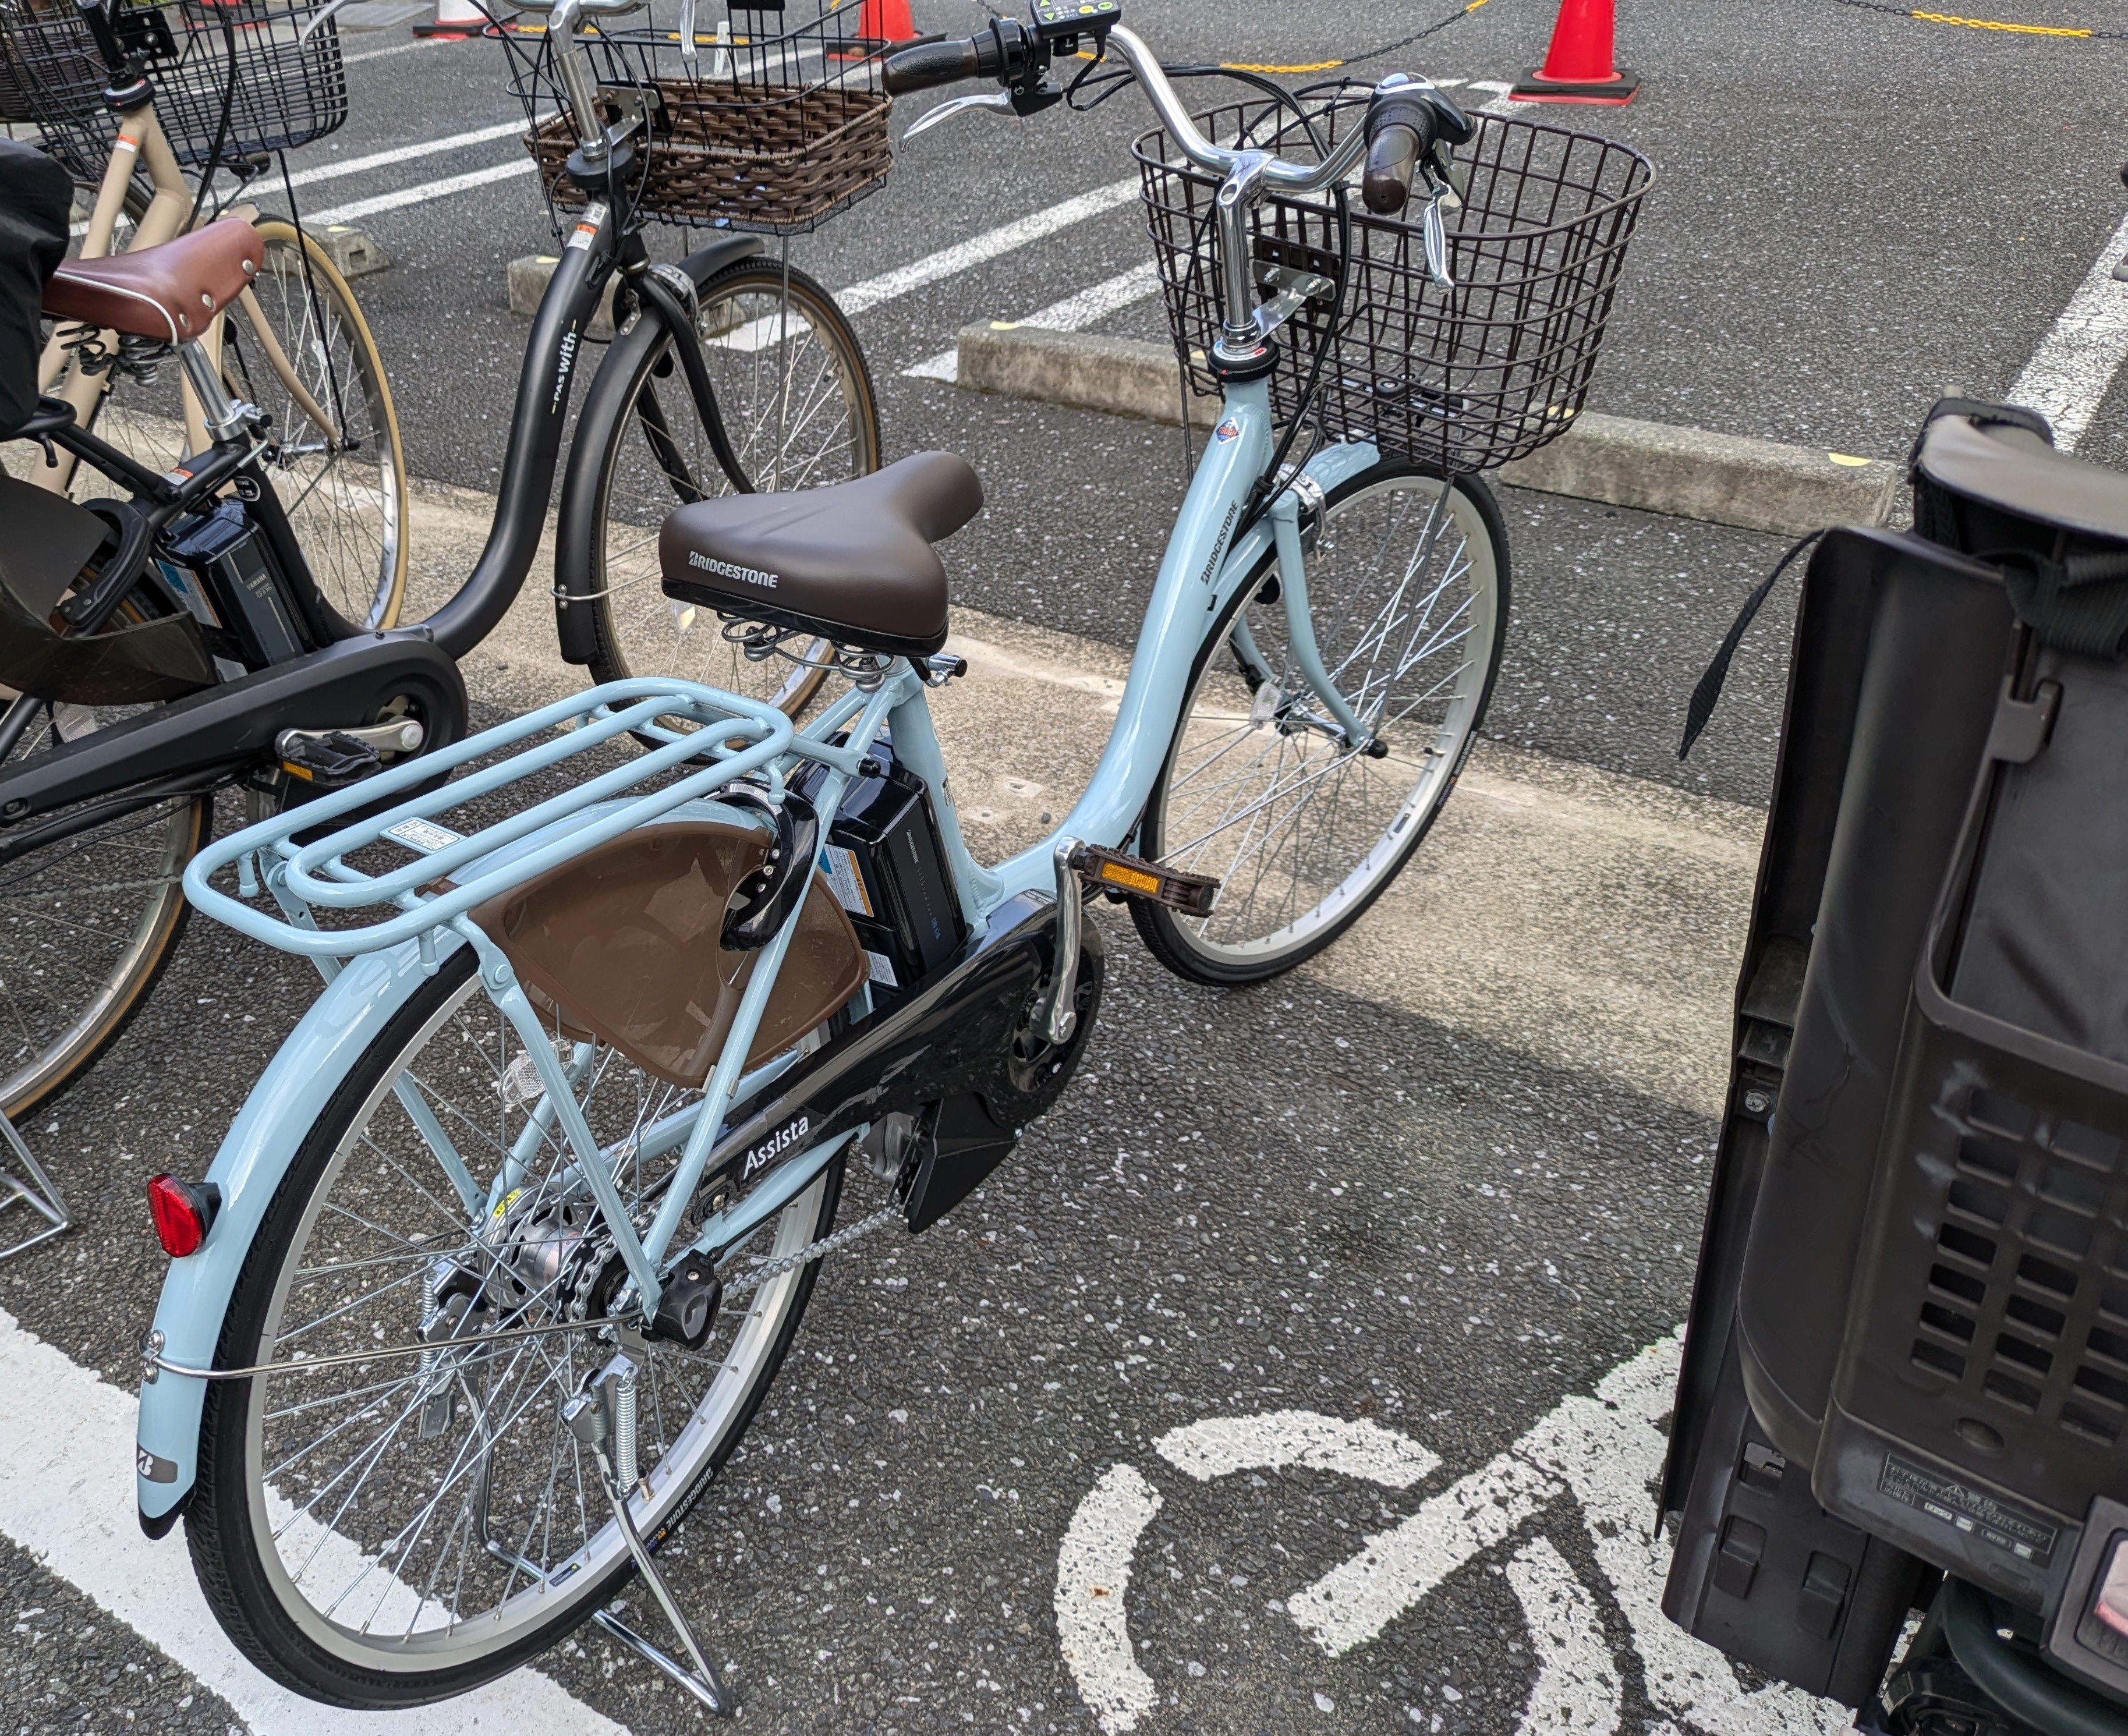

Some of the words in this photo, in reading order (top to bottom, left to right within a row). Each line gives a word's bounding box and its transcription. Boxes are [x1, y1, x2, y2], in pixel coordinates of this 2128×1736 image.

[554, 374, 565, 402] PAS
[1200, 499, 1239, 586] BRIDGESTONE
[247, 573, 267, 590] YAMAHA
[688, 551, 778, 589] BRIDGESTONE
[906, 830, 919, 863] BRIDGESTONE
[743, 1117, 809, 1180] Assista
[665, 1466, 714, 1531] BRIDGESTONE
